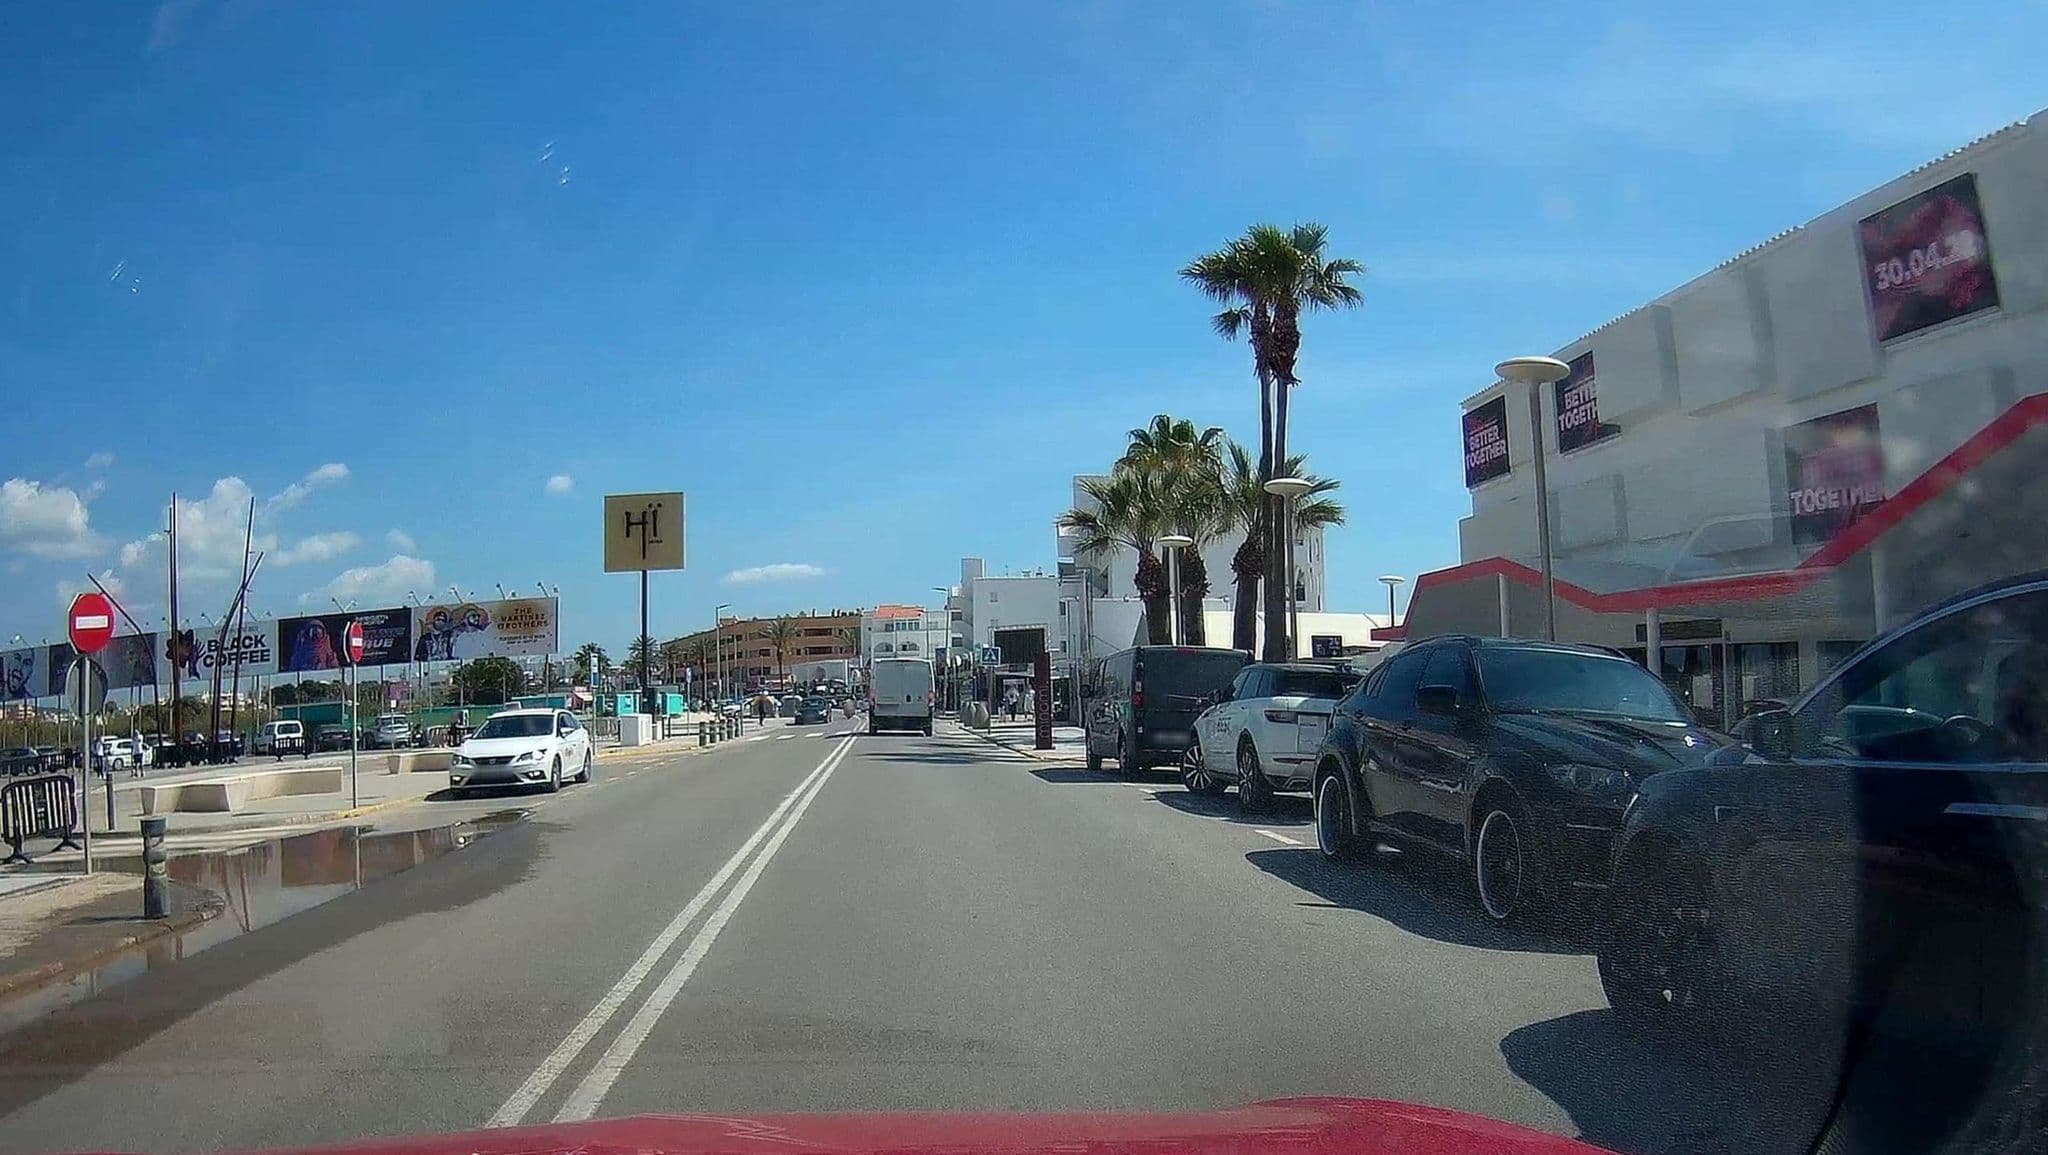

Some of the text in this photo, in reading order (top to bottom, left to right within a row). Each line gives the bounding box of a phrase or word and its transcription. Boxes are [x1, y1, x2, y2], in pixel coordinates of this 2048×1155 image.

[1559, 400, 1601, 431] TOGETH
[1470, 425, 1499, 451] BETTER
[1467, 440, 1506, 470] TOGETHER
